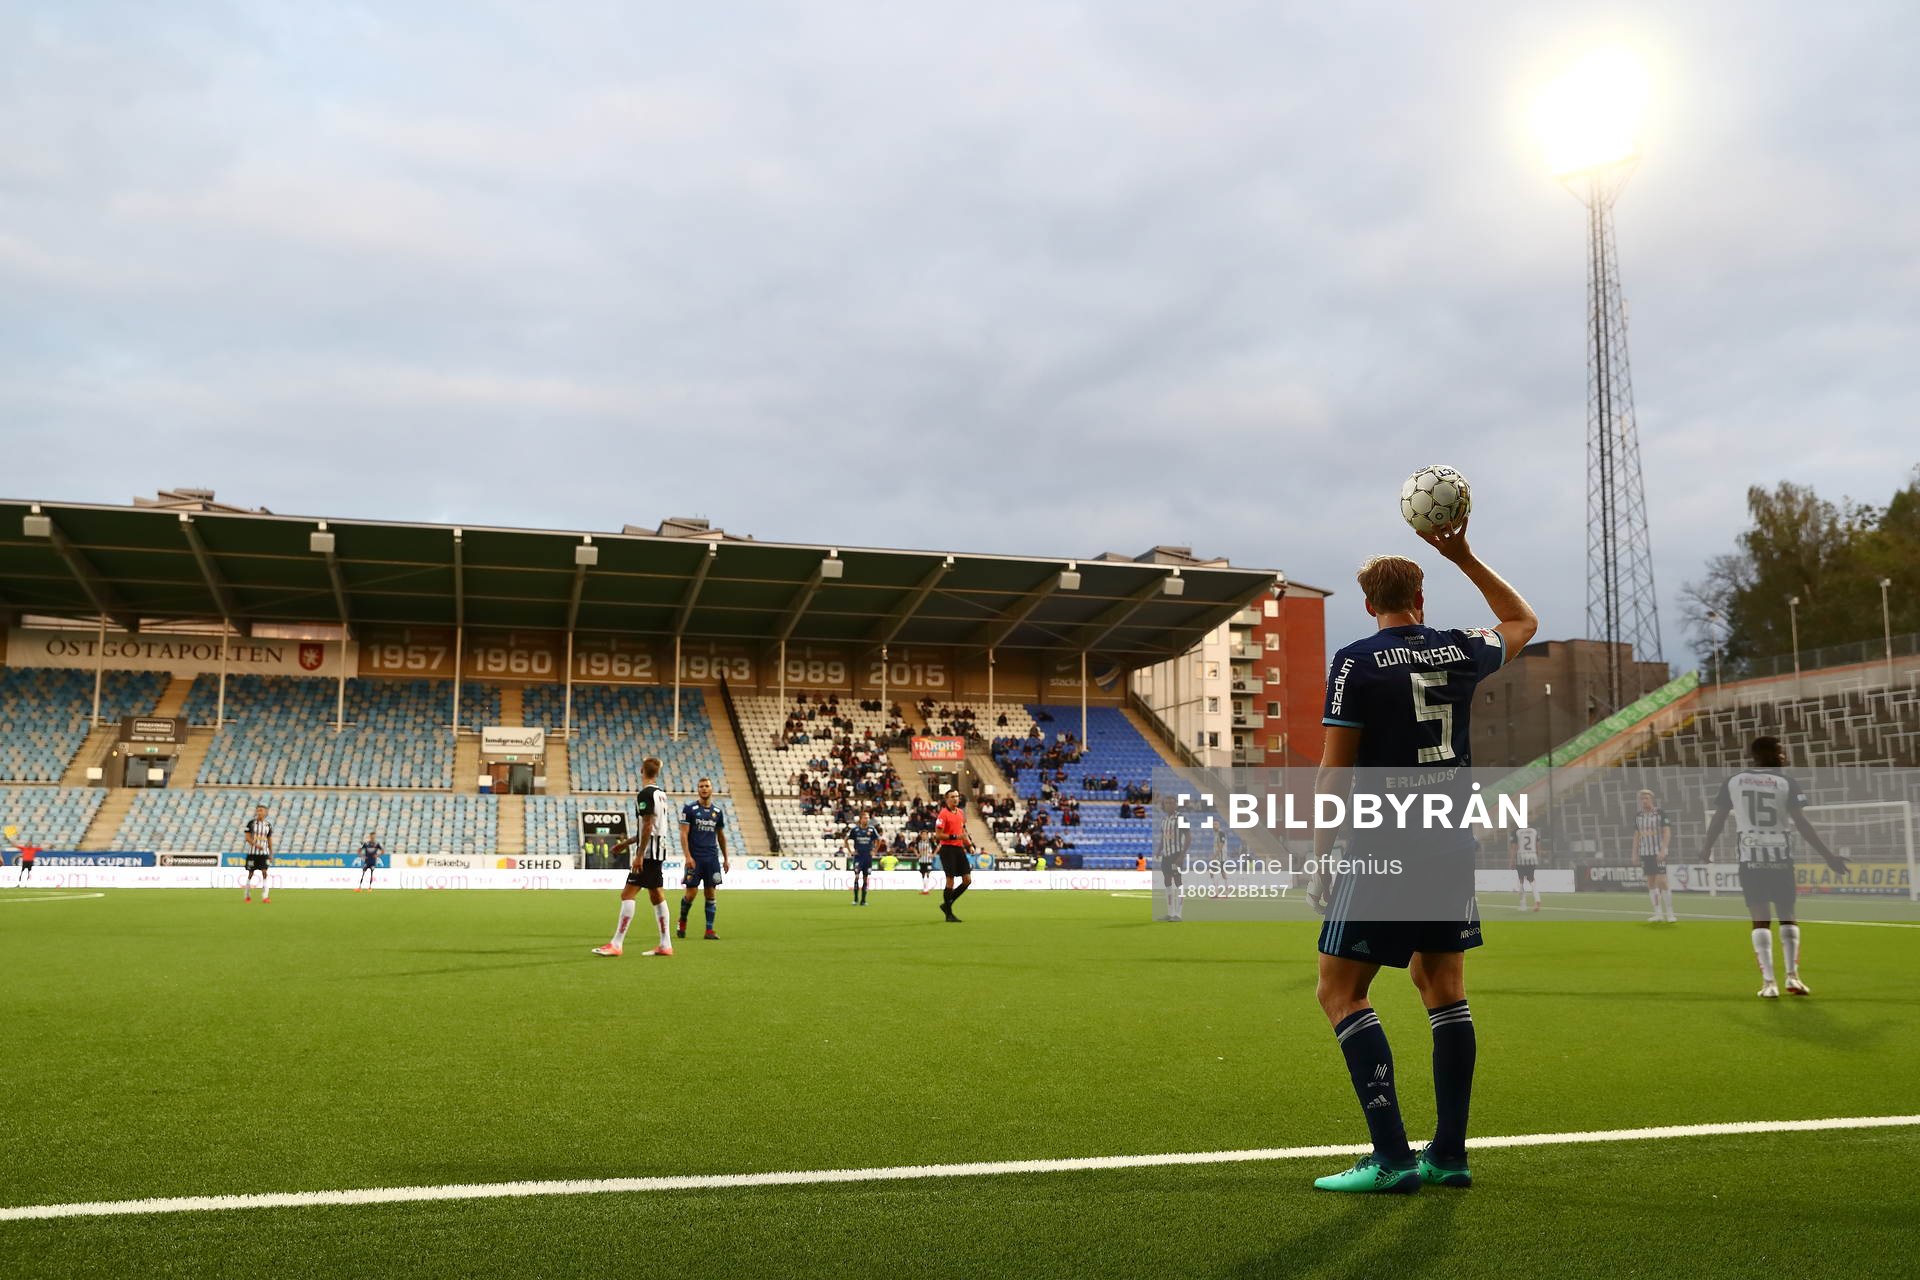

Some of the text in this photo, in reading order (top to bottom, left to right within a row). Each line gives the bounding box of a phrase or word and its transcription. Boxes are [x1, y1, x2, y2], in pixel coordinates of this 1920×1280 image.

[46, 635, 284, 664] ÖSTGÖTAPORTEN
[368, 644, 447, 670] 1957
[474, 647, 552, 673] 1960
[576, 653, 653, 678] 1962
[678, 656, 750, 681] 1963
[774, 659, 846, 684] 1989
[869, 662, 945, 687] 2015
[1331, 657, 1355, 716] stadium
[1410, 671, 1456, 764] 5
[1386, 765, 1459, 790] ERLANDS
[584, 814, 622, 824] exeo
[1742, 790, 1778, 827] 15
[1524, 836, 1532, 851] 2
[37, 857, 142, 867] SVENSKA CUPEN
[426, 858, 471, 869] Fiskeby
[518, 859, 562, 869] SEHED
[1590, 867, 1648, 881] OPTIMER
